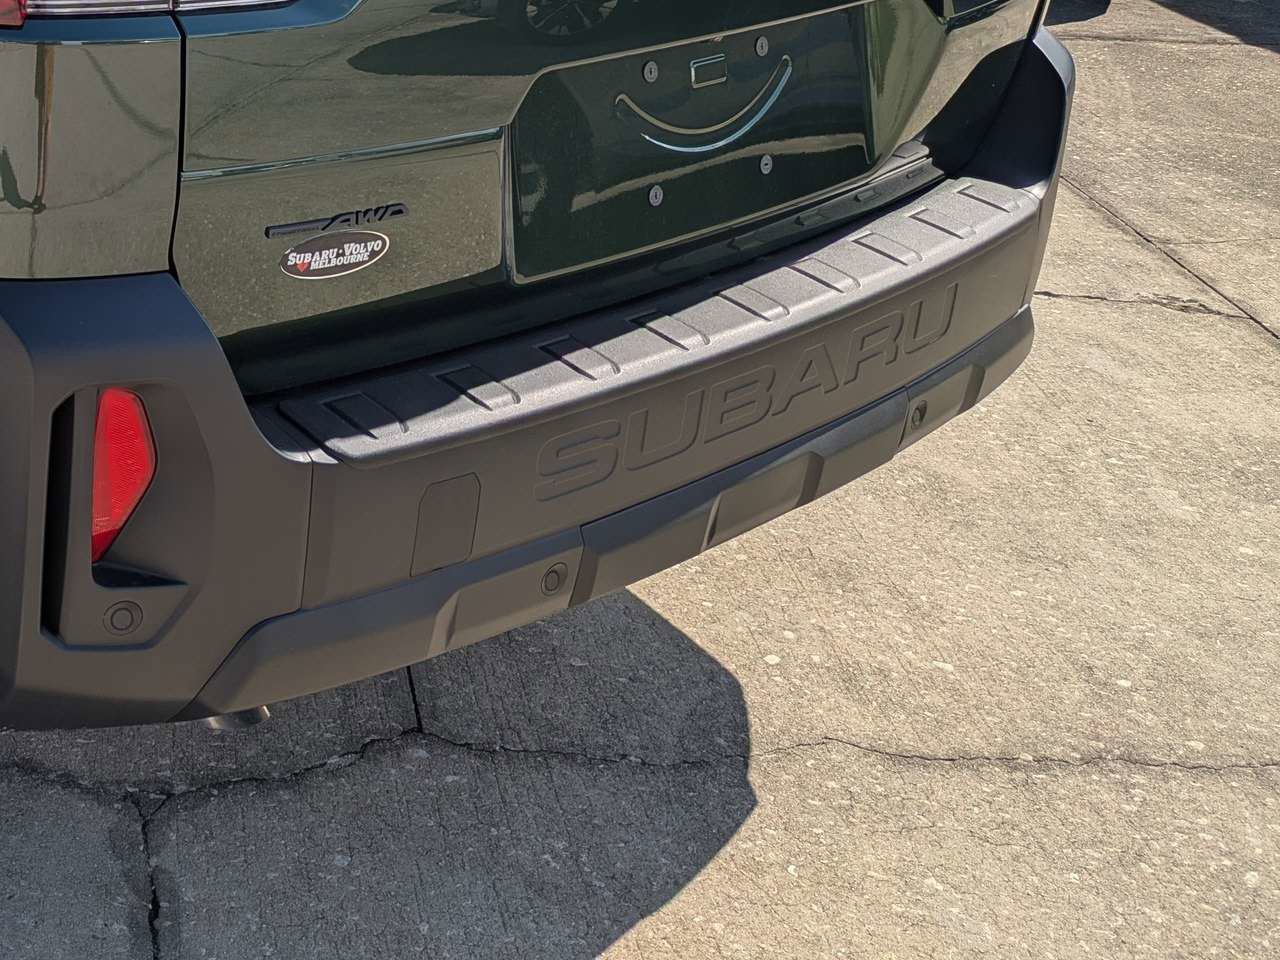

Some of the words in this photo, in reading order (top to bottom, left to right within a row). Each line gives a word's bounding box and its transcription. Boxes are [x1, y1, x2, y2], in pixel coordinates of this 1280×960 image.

[321, 202, 409, 232] AWD
[287, 248, 338, 265] SUBARU
[344, 240, 382, 256] VOLVO
[310, 252, 370, 270] MELBOURNE
[534, 282, 959, 503] SUBARU
